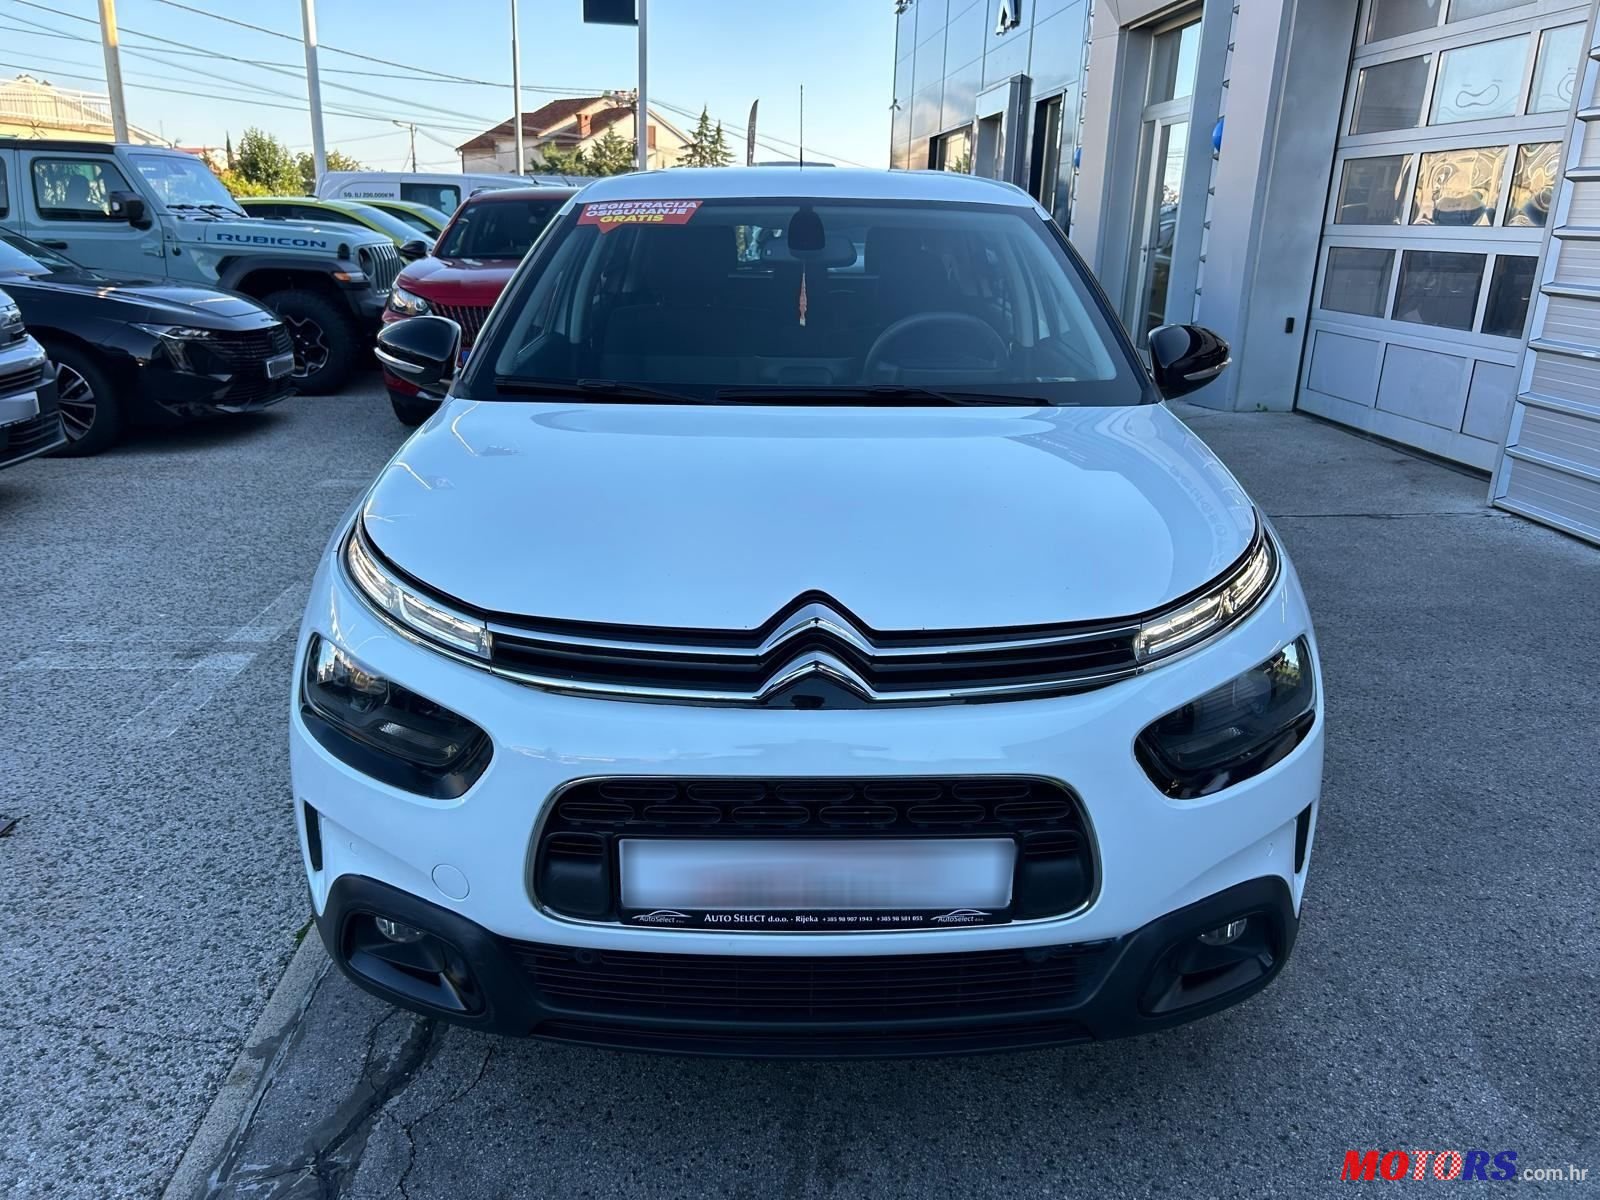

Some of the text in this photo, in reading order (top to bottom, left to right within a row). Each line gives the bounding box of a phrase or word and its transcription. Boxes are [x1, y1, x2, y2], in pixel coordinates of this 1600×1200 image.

[587, 200, 698, 211] REGISTRACIJA
[585, 207, 688, 217] OSIGURANJE
[599, 214, 665, 223] GRATIS
[216, 233, 327, 249] RUBICON
[639, 915, 675, 923] AutoSelect
[704, 913, 731, 923] AUTO
[733, 913, 766, 923] SELECT
[767, 914, 789, 923] d.o.o.
[795, 914, 819, 925] Rijeka
[937, 915, 974, 923] AutoSelect
